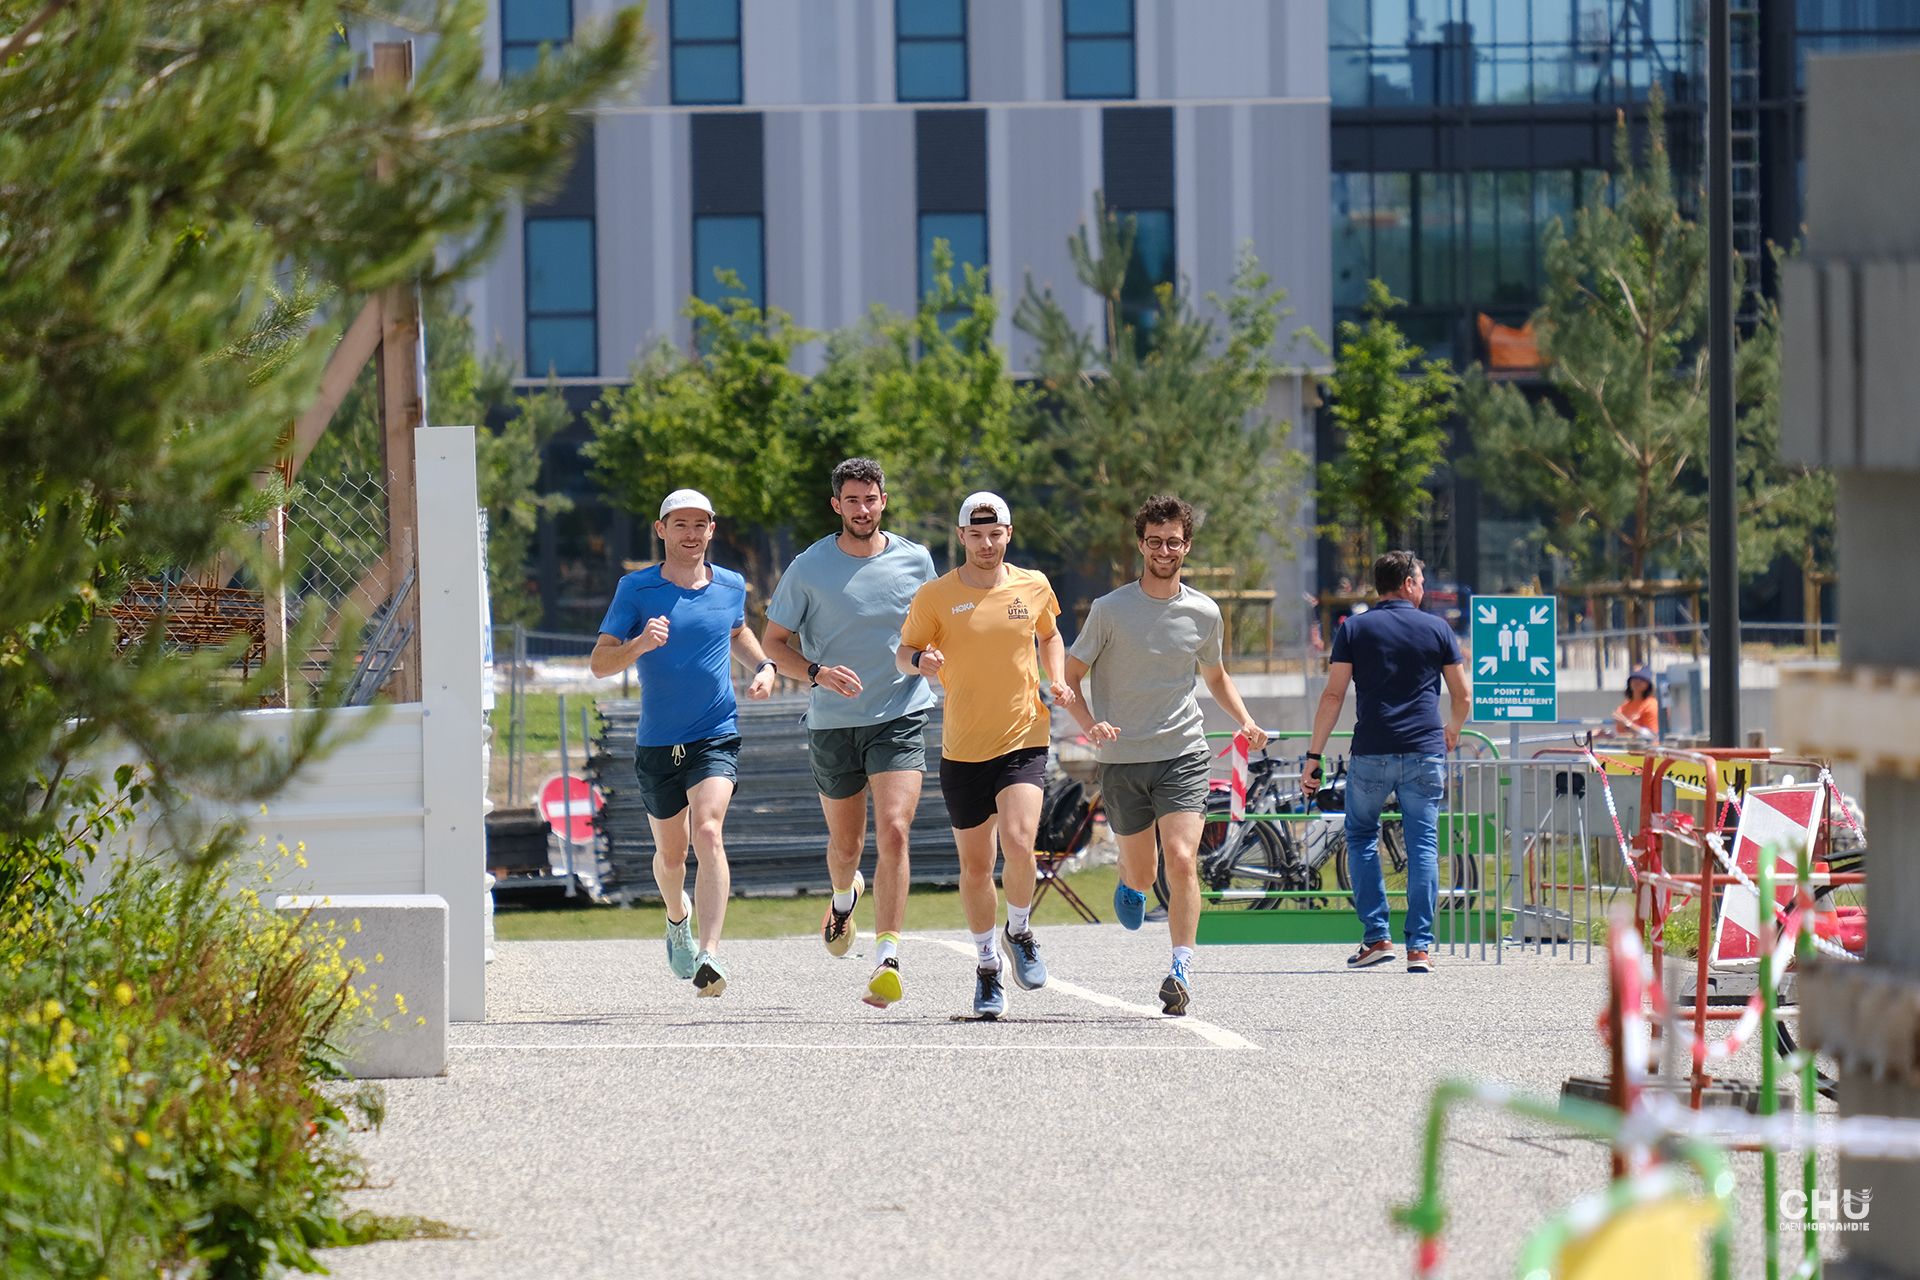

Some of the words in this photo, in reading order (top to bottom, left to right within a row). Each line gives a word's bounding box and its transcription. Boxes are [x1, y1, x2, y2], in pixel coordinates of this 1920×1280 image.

[951, 602, 975, 615] HOKA
[1493, 688, 1521, 696] POINT
[1523, 688, 1535, 696] DE
[1475, 697, 1554, 705] RASSEMBLEMENT
